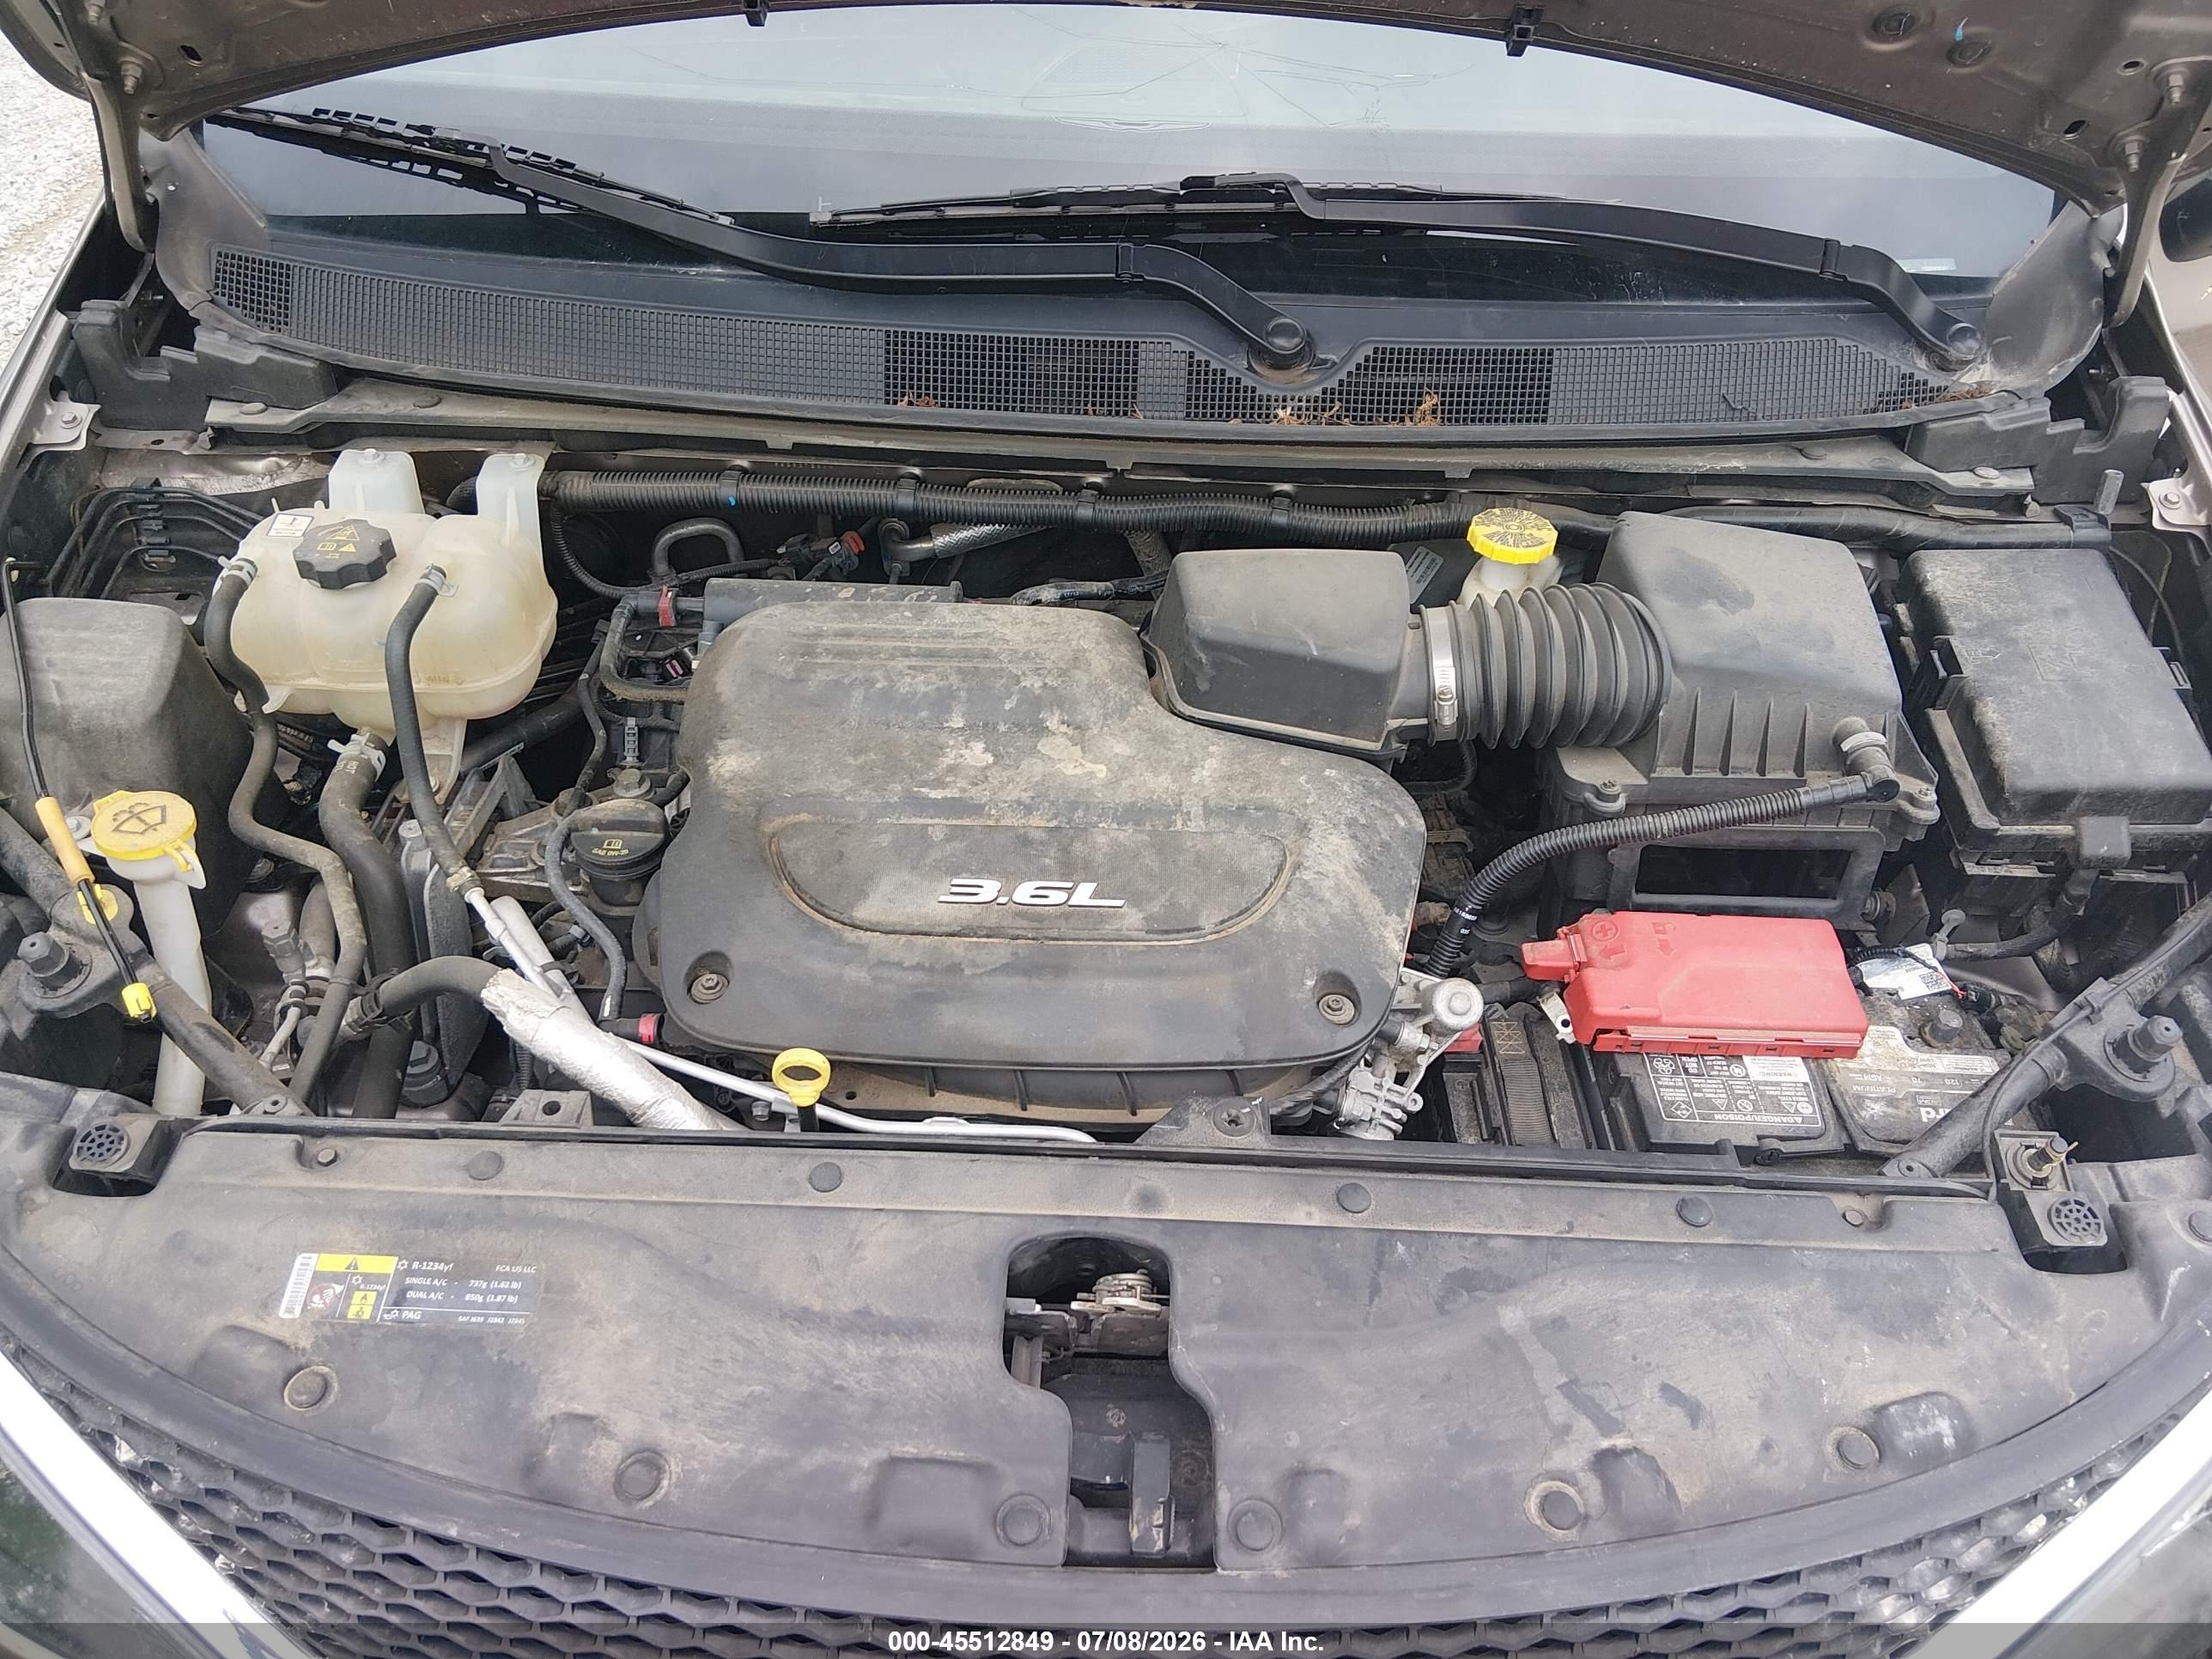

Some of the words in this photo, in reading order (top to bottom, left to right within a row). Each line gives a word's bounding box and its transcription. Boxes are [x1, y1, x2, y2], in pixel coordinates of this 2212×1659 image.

[938, 878, 1127, 908] 3.6L
[1852, 1085, 1897, 1093] PLATINUM
[1714, 1114, 1795, 1123] DANGER/POISON
[411, 1261, 454, 1273] R-1234yf
[431, 1278, 448, 1286] A/C
[469, 1279, 488, 1289] 737g
[510, 1281, 522, 1290] lb)
[428, 1291, 445, 1300] A/C
[507, 1295, 519, 1304] lb)
[401, 1310, 422, 1320] PAG
